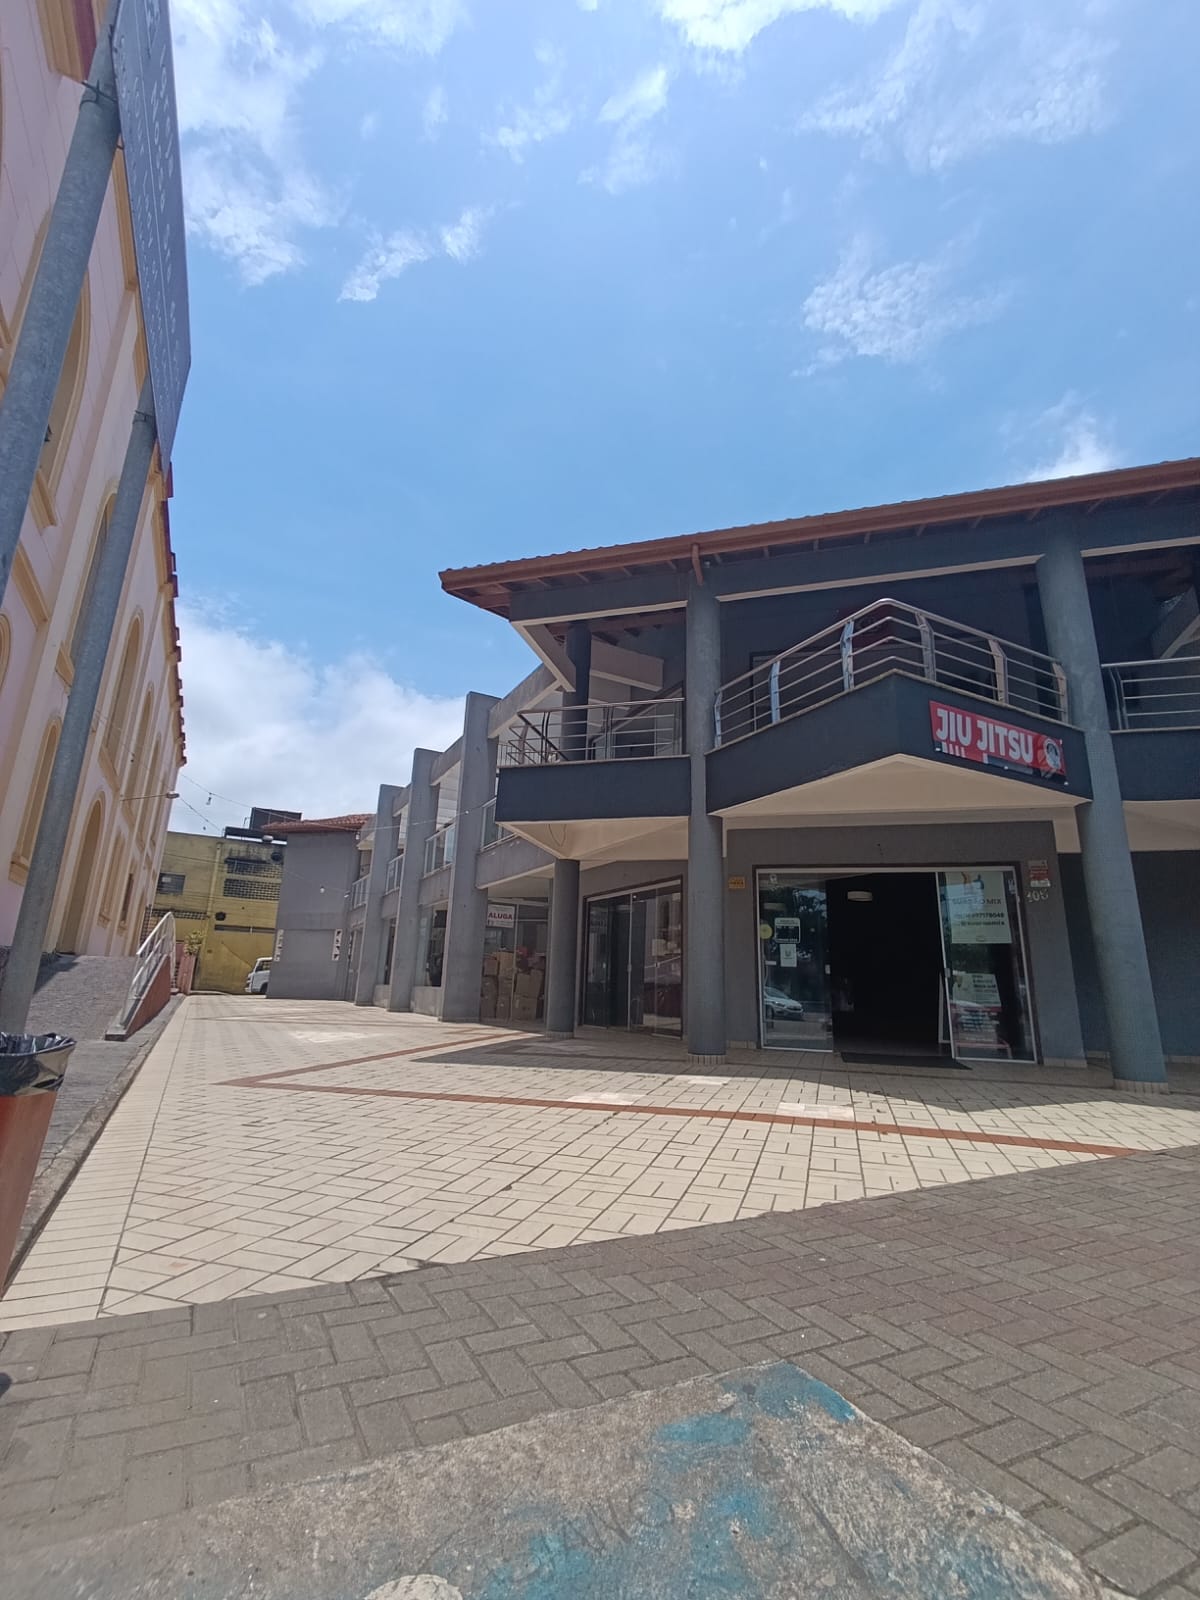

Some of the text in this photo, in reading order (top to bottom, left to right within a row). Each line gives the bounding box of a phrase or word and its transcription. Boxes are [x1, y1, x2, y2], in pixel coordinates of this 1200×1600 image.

[936, 708, 972, 746] JIU
[977, 720, 1034, 763] JITSU
[488, 912, 512, 920] ALUGA
